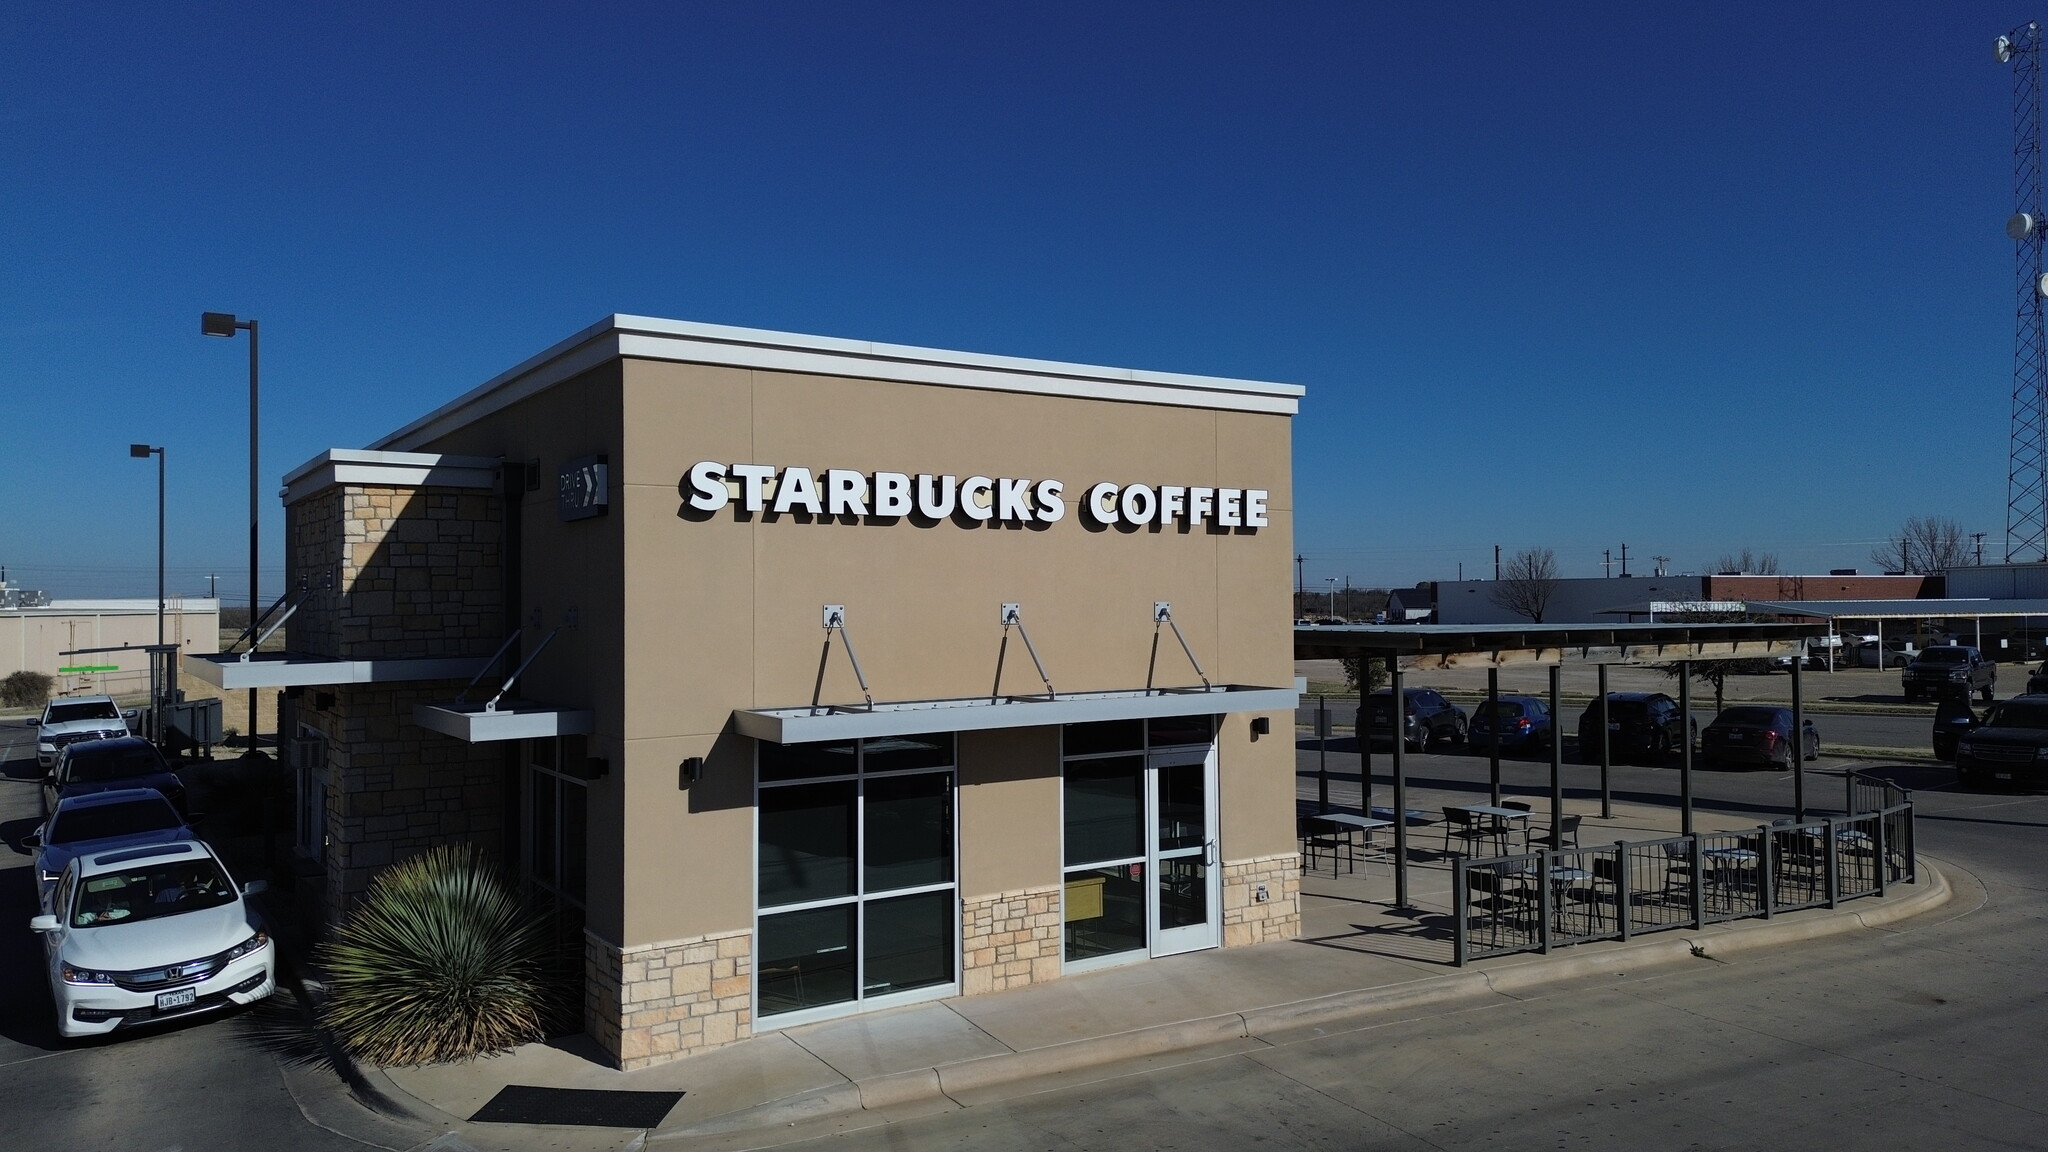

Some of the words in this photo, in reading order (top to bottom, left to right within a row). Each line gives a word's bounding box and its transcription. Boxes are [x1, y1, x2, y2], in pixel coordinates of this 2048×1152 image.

[560, 470, 580, 491] DRIVE
[560, 491, 580, 510] THRU
[688, 460, 1065, 523] STARBUCKS
[1089, 482, 1269, 528] COFFEE
